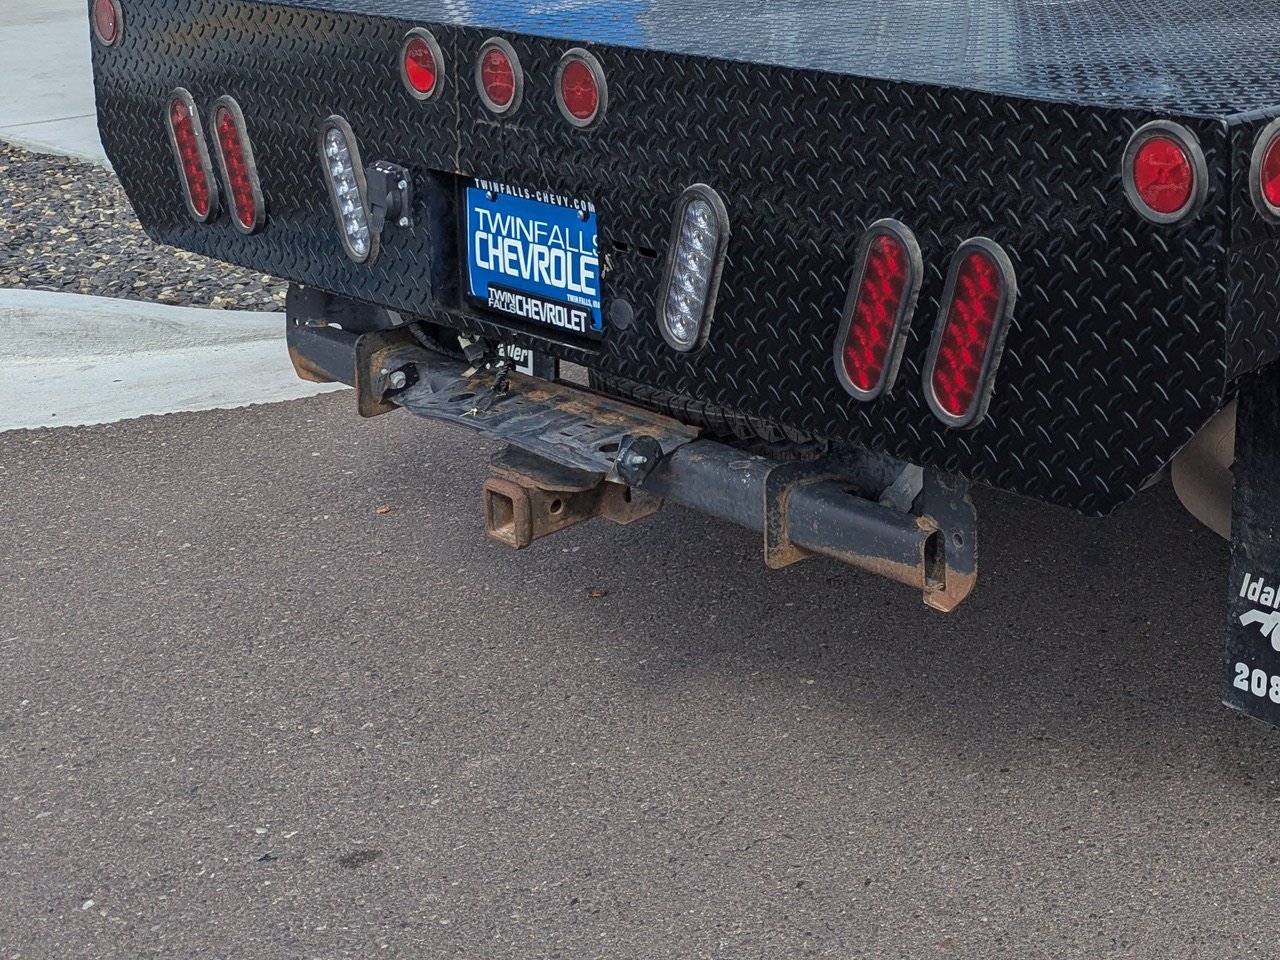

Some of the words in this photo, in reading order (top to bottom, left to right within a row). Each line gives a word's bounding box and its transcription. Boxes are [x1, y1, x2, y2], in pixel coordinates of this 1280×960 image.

[474, 178, 596, 214] TWINFALLS-CHEVY.COM
[487, 287, 516, 304] TWIN
[488, 297, 516, 314] FALLS
[515, 294, 587, 333] CHEVROLET
